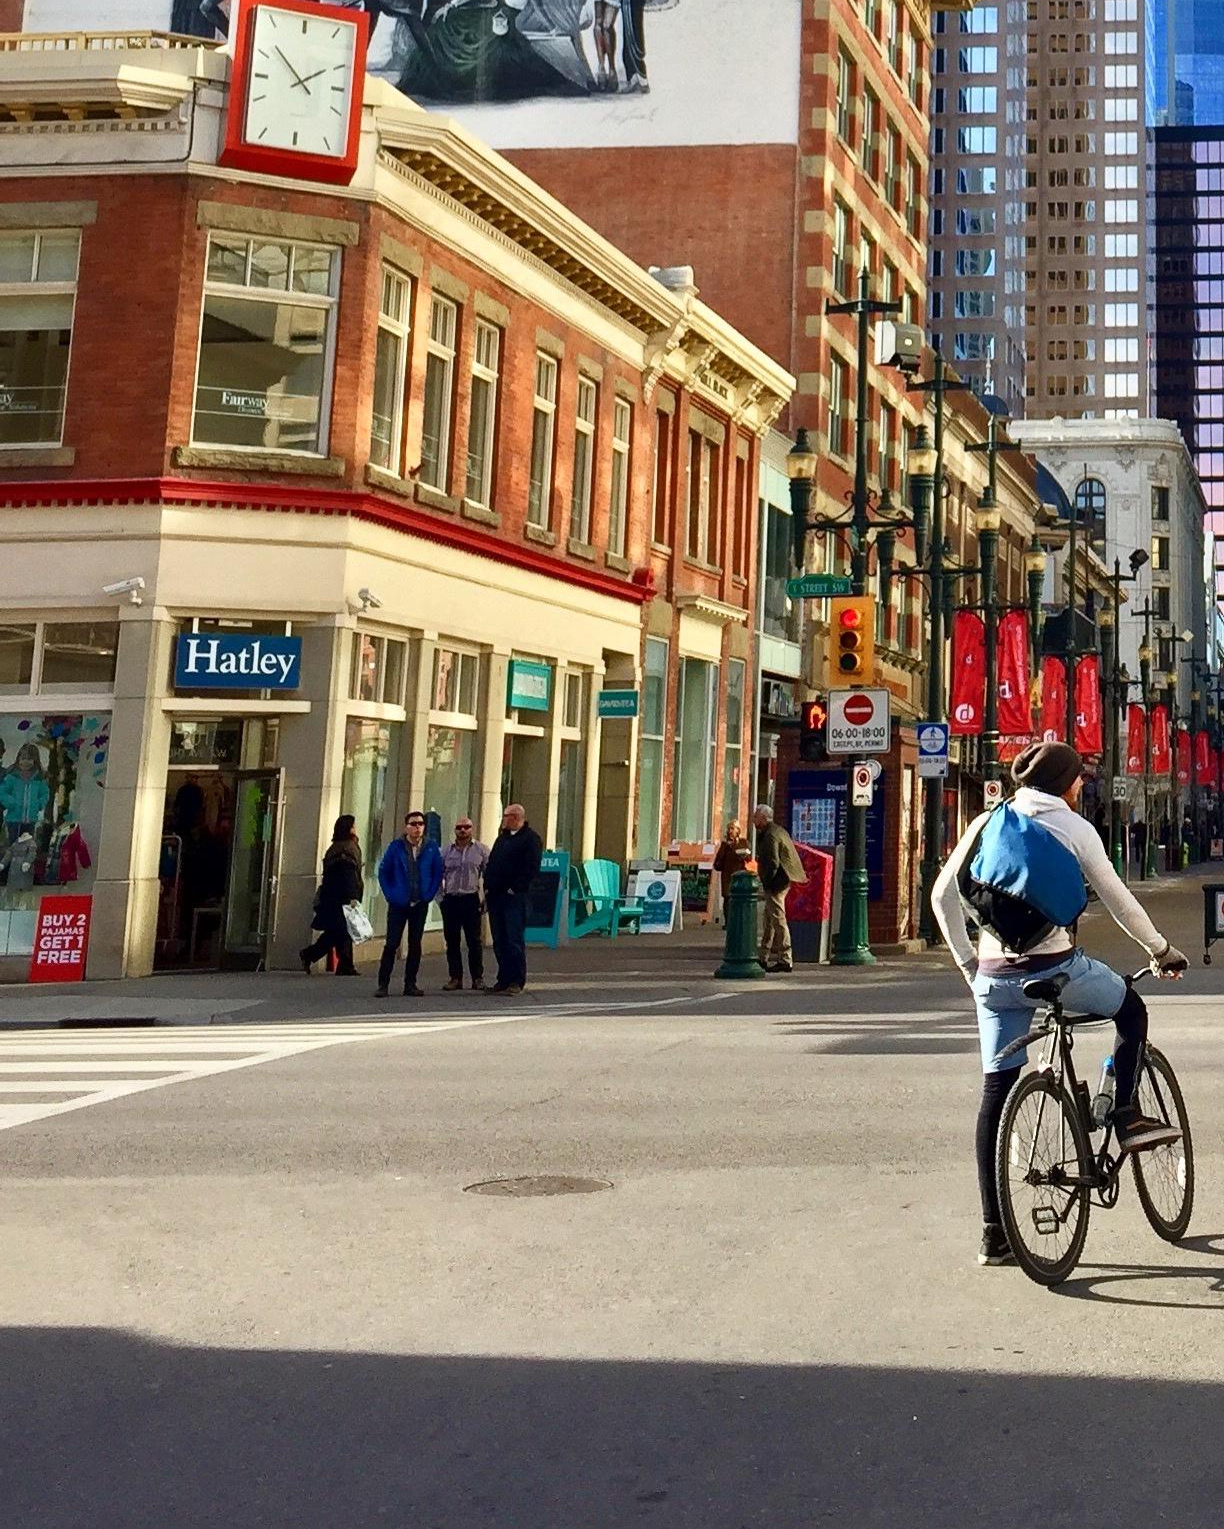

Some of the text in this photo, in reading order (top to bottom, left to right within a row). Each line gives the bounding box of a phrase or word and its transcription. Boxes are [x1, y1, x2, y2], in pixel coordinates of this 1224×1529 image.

[221, 391, 270, 413] Fairway
[800, 583, 828, 593] STREET
[832, 583, 845, 591] SW
[185, 639, 296, 683] Hatley
[42, 913, 87, 927] BUY 2
[41, 927, 85, 936] PAJAMAS
[40, 935, 84, 949] GET 1
[37, 950, 81, 965] FREE
